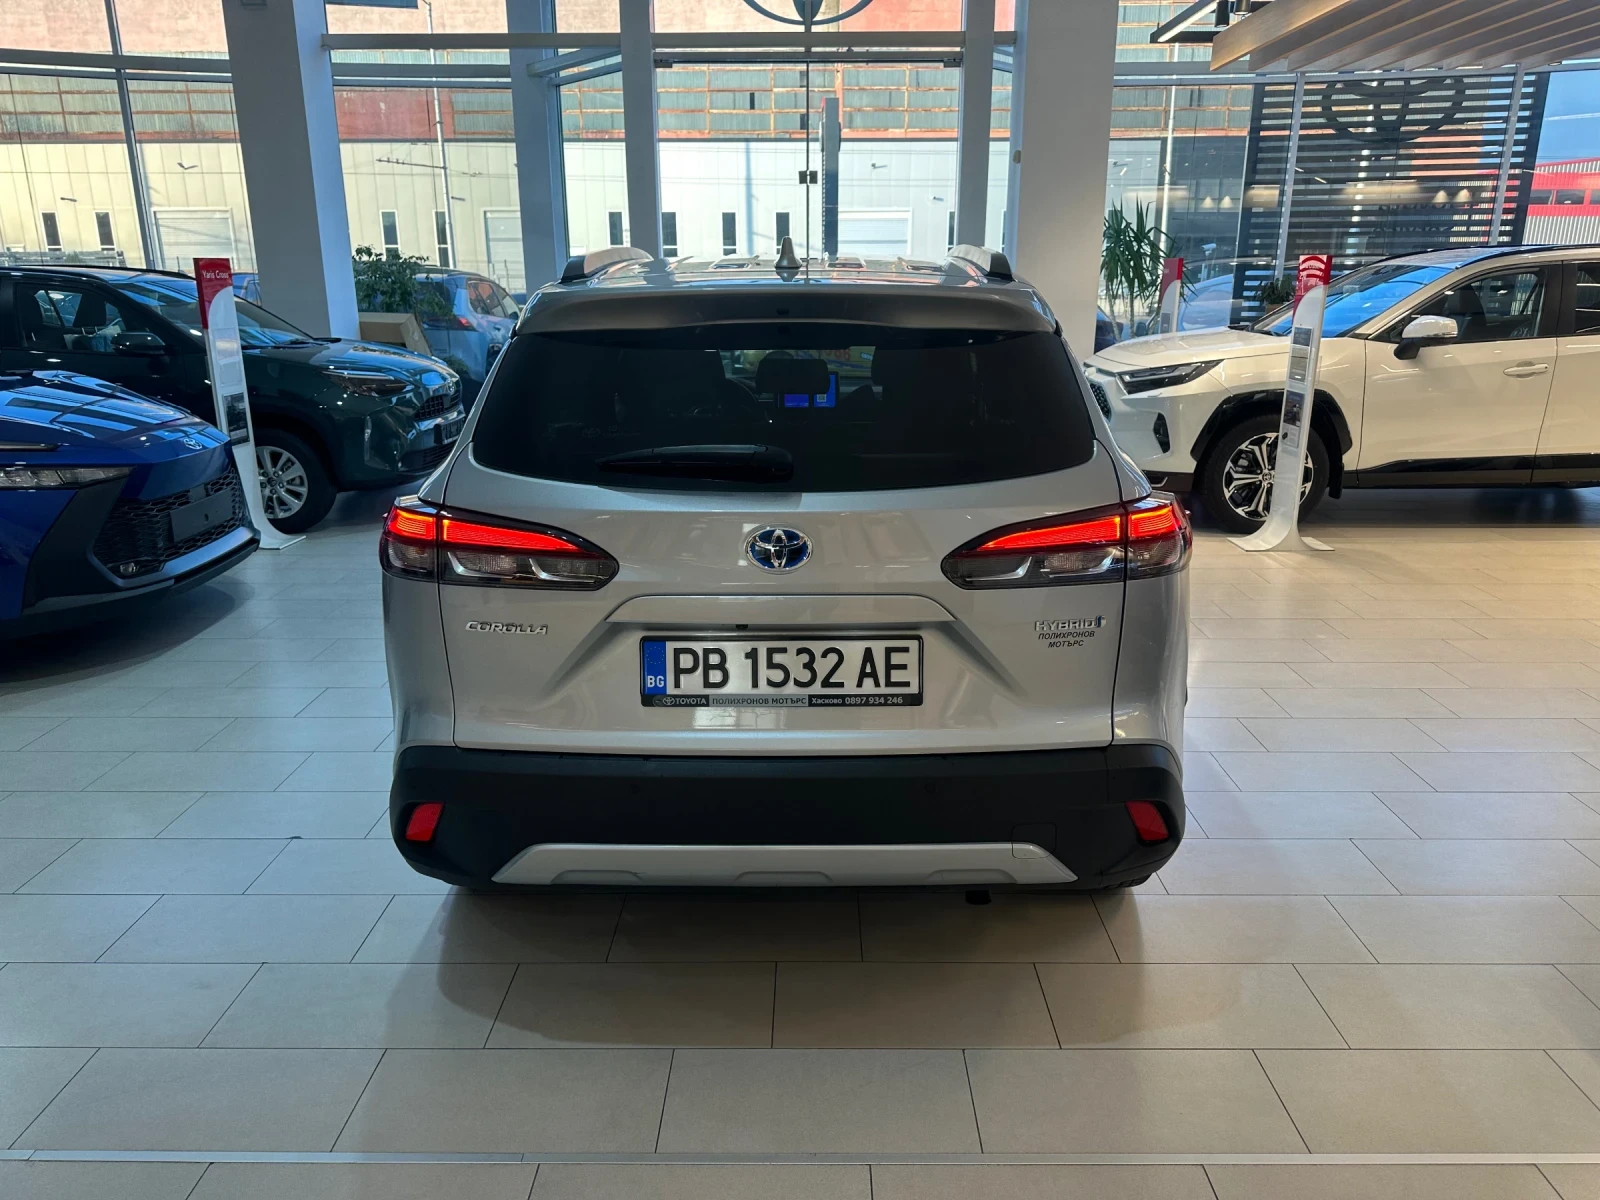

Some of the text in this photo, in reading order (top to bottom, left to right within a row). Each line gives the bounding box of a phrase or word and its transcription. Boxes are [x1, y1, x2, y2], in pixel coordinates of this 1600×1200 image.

[202, 270, 229, 279] Yaris Cross
[465, 620, 548, 635] COROLLA
[1035, 618, 1096, 631] HYBRID
[1038, 631, 1095, 640] ПОЛИХРОНОВ
[1048, 640, 1084, 648] МОТЪРС
[673, 646, 911, 689] PB 1532 AE
[646, 675, 665, 688] BG
[675, 697, 707, 705] TOYOTA
[712, 696, 807, 705] ПОЛИХРОНОВ МОТЪРС
[811, 696, 903, 705] Хасково 0897 934 246
